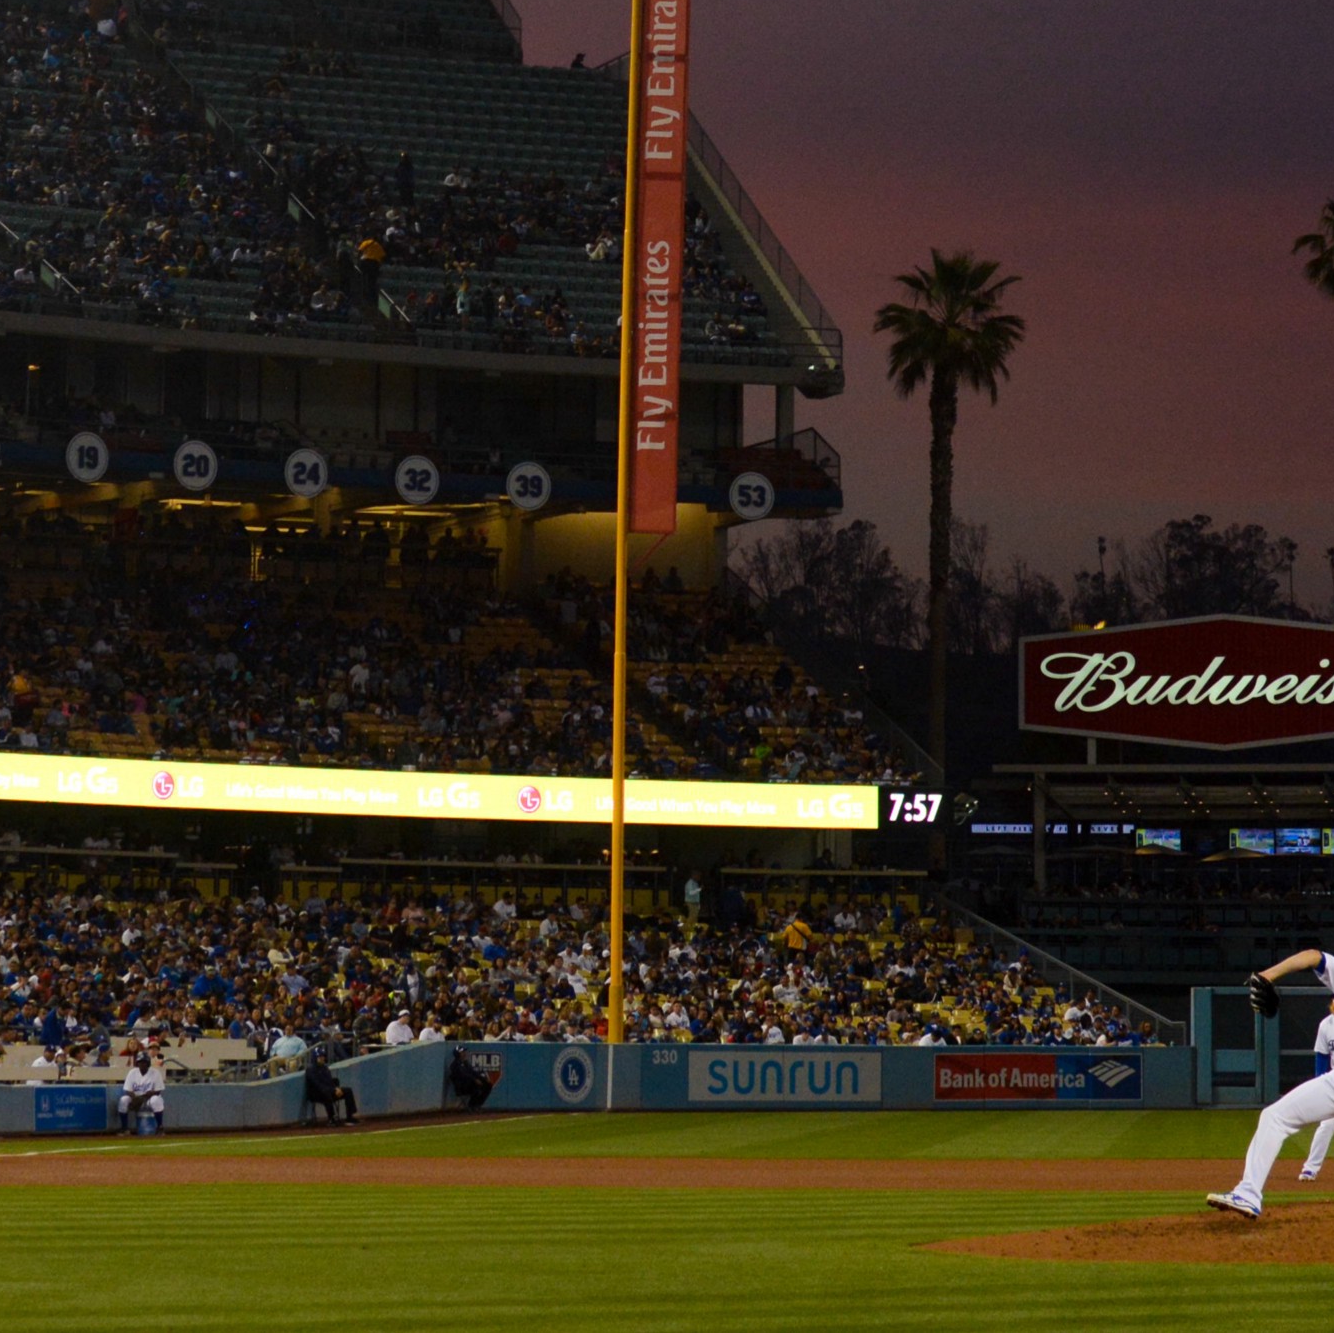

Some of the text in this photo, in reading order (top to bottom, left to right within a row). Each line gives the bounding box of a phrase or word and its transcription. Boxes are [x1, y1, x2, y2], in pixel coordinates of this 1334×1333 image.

[645, 107, 680, 160] Fly
[637, 240, 672, 451] Fly Emirates
[77, 445, 99, 468] 19
[183, 453, 210, 478] 20
[293, 462, 320, 485] 24
[403, 468, 431, 492] 32
[514, 474, 543, 497] 39
[737, 484, 767, 508] 53
[58, 771, 82, 793] LG
[178, 776, 204, 797] LG
[418, 787, 443, 808] LG
[544, 790, 573, 811] LG
[625, 797, 657, 812] Good
[797, 798, 824, 819] LG
[889, 793, 943, 823] 7:57
[471, 1054, 501, 1067] MLB
[652, 1050, 678, 1064] 330
[567, 1063, 579, 1086] LA
[706, 1058, 859, 1094] sunrun
[940, 1068, 1085, 1088] Bank of America
